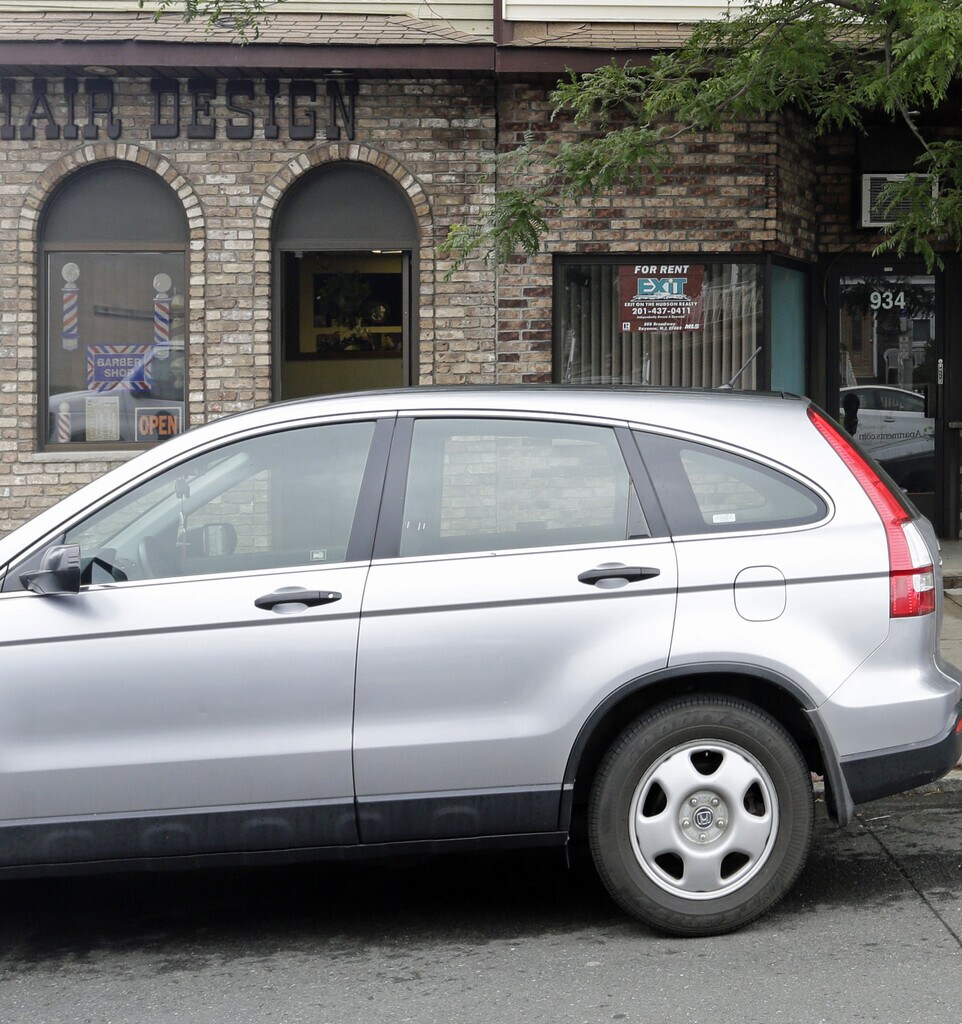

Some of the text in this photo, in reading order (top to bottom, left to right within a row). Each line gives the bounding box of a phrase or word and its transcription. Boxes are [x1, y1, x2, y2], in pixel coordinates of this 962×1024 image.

[150, 77, 359, 140] DESIGN
[634, 265, 690, 274] FOR RENT
[870, 291, 906, 310] 934
[632, 307, 691, 315] 201-437-0411
[97, 357, 142, 367] BARBER
[104, 368, 134, 378] SHOP
[140, 414, 178, 435] OPEN
